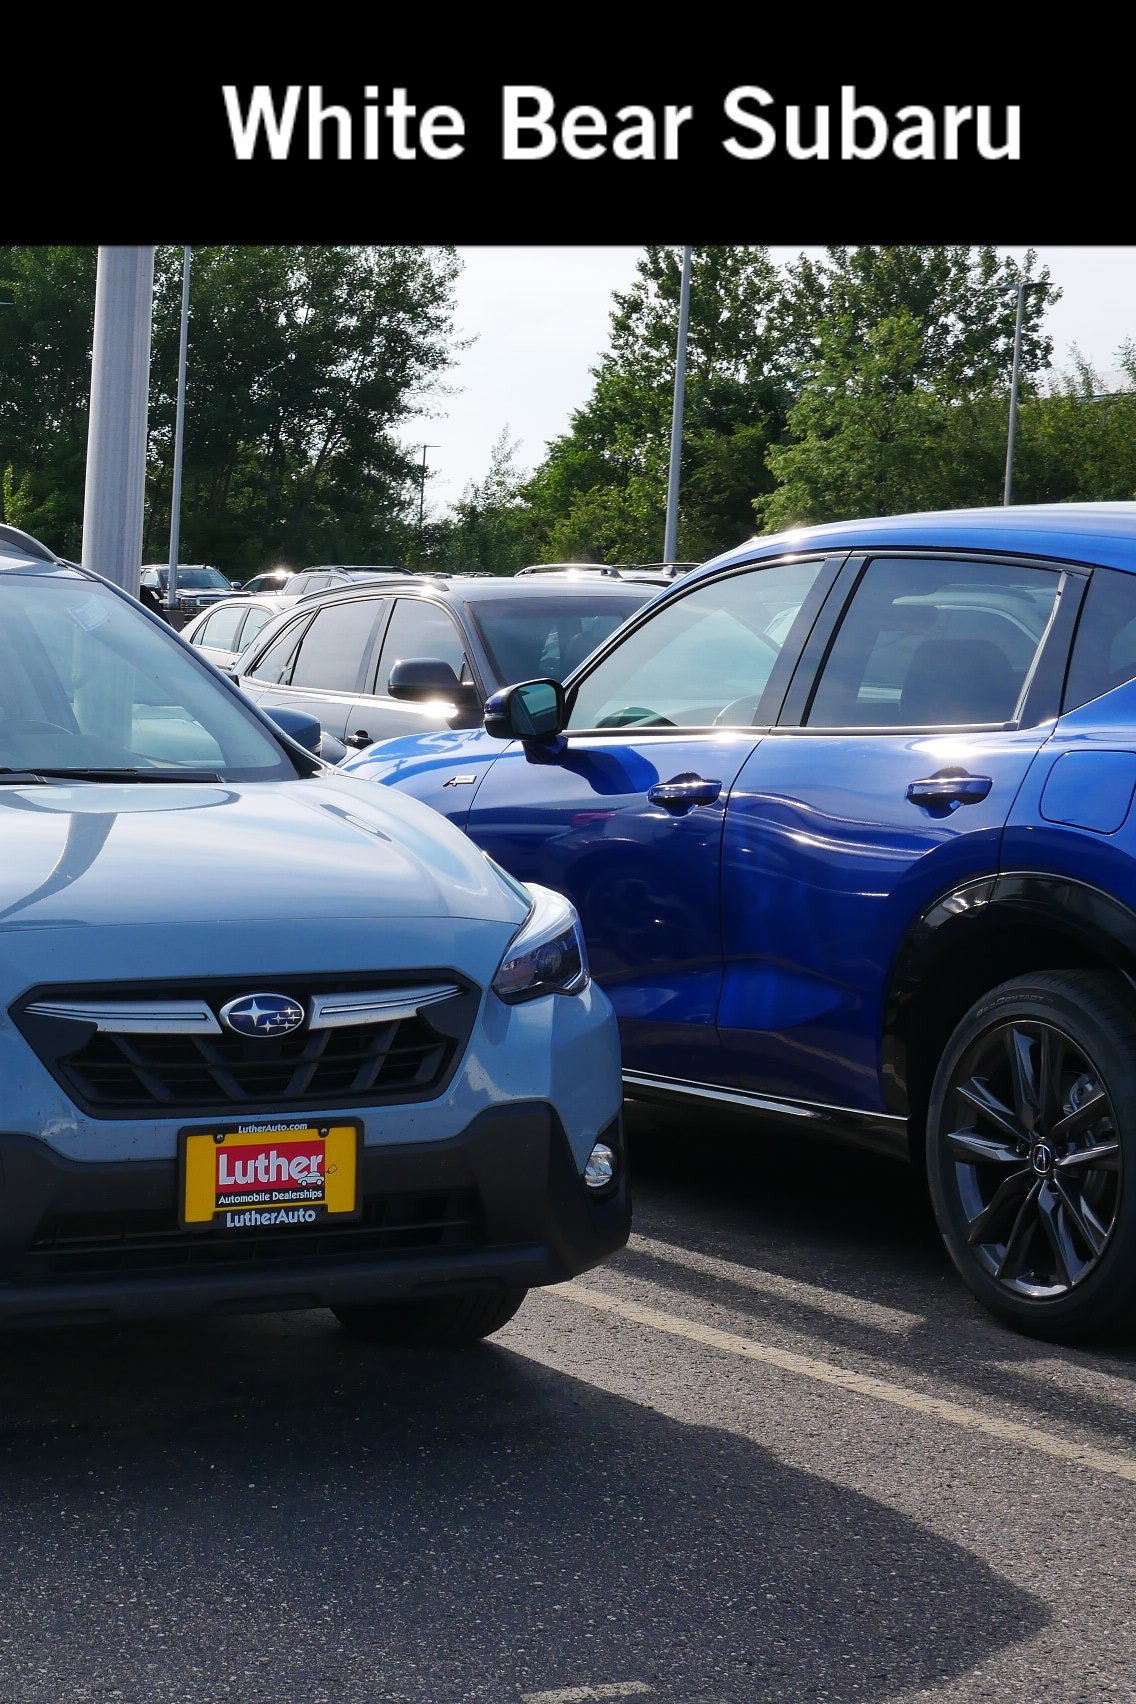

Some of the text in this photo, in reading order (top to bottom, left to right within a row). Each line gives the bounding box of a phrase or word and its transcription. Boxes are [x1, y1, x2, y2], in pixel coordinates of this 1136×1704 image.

[238, 1123, 308, 1134] LutherAuto.com
[219, 1150, 323, 1185] Luther
[218, 1190, 323, 1204] Automobile Dealerships
[226, 1208, 317, 1228] LutherAuto
